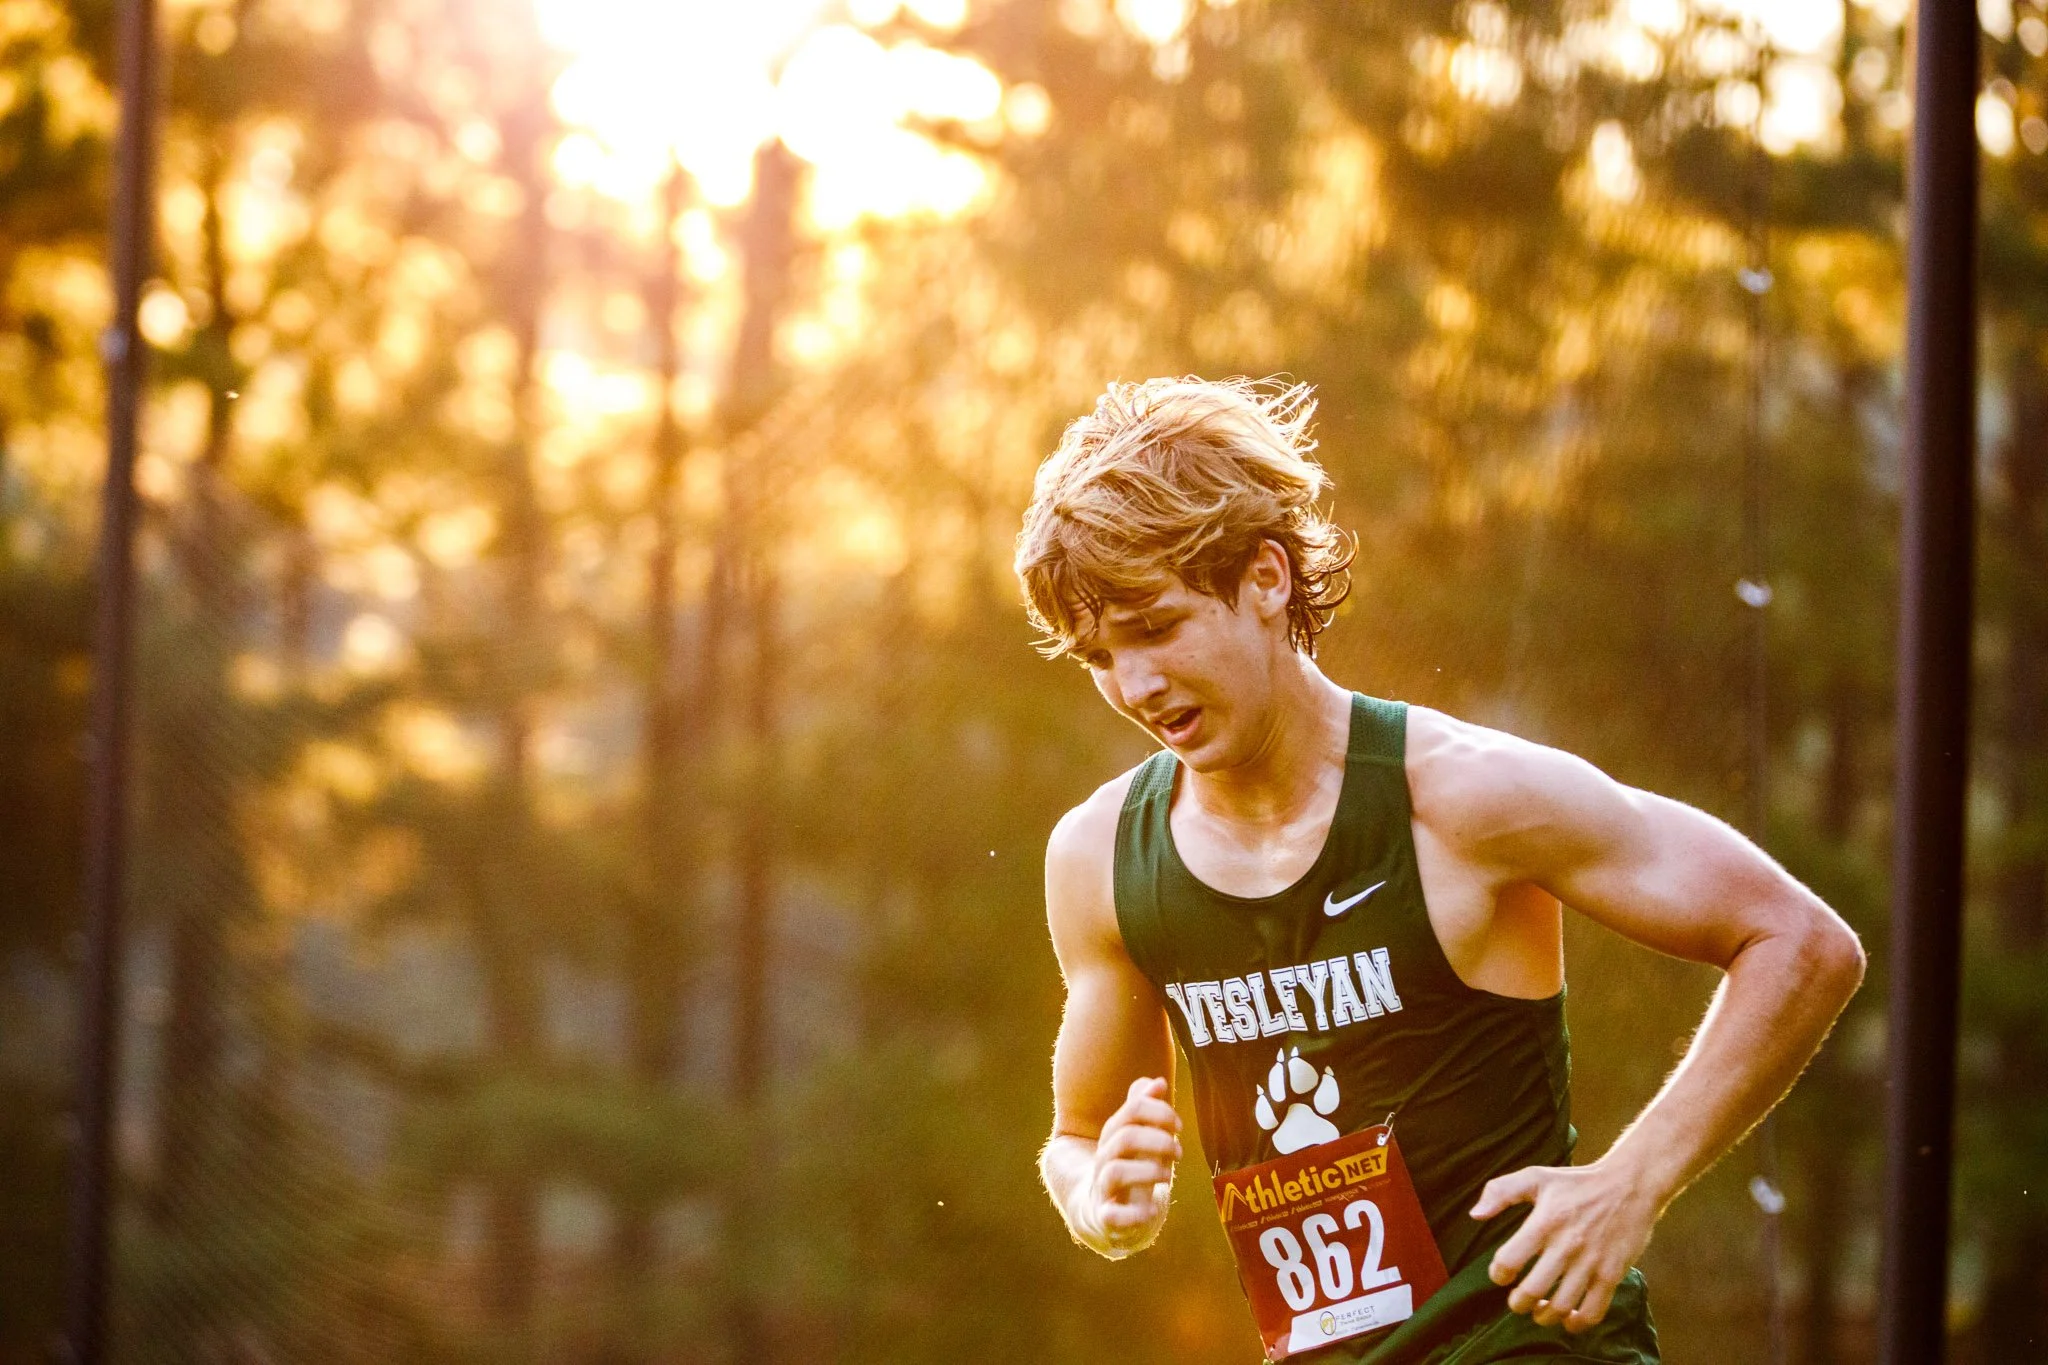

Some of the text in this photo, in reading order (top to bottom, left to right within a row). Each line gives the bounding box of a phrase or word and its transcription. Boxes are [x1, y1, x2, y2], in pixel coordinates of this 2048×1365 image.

[1222, 1154, 1382, 1223] Athletic NET
[1259, 1199, 1402, 1312] 862
[1336, 1305, 1375, 1320] PERFECT
